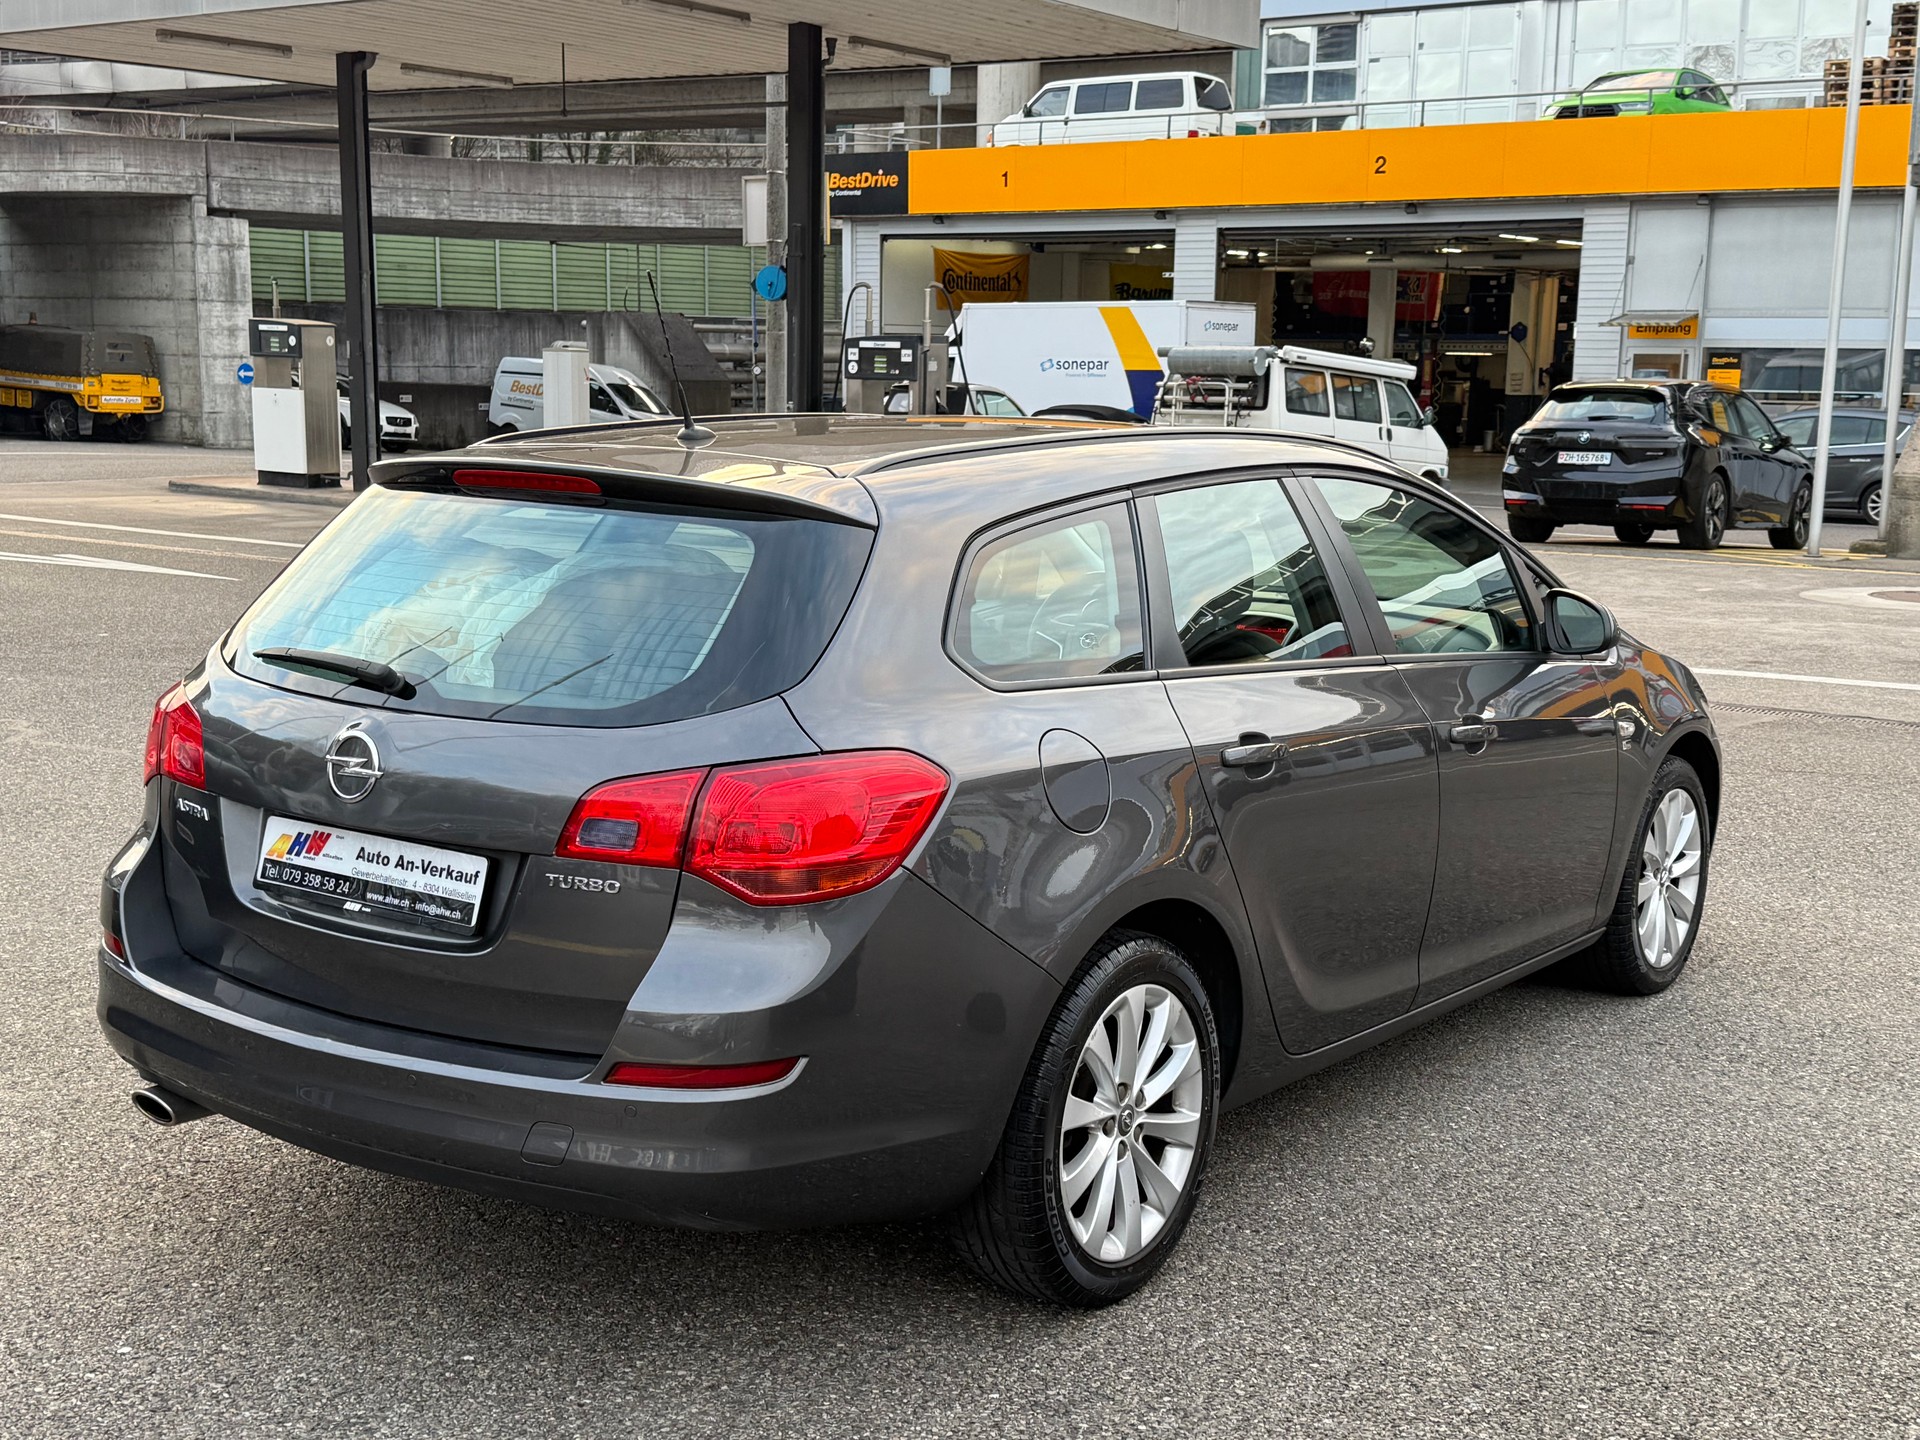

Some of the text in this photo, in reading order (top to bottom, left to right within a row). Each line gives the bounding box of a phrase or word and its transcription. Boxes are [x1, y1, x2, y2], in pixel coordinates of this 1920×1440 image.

[1375, 156, 1386, 174] 2
[829, 169, 899, 188] BestDrive
[1002, 171, 1008, 187] 1
[942, 268, 1011, 294] Continental
[1212, 322, 1239, 332] sonepar
[1056, 360, 1109, 372] sonepar
[176, 798, 209, 821] ASTRA
[266, 830, 332, 859] AHW
[356, 847, 480, 885] Auto An-Verkauf
[265, 863, 350, 894] Tel. 079 358 58 24
[351, 867, 409, 887] Gewerbehallenstr.
[412, 881, 418, 889] 4
[423, 882, 440, 893] 8304
[441, 886, 477, 901] Wallisellen
[545, 873, 621, 894] TURBO
[366, 892, 410, 908] www.ahw.ch
[415, 900, 461, 919] info@ahw.ch
[1045, 1158, 1070, 1257] COOPER
